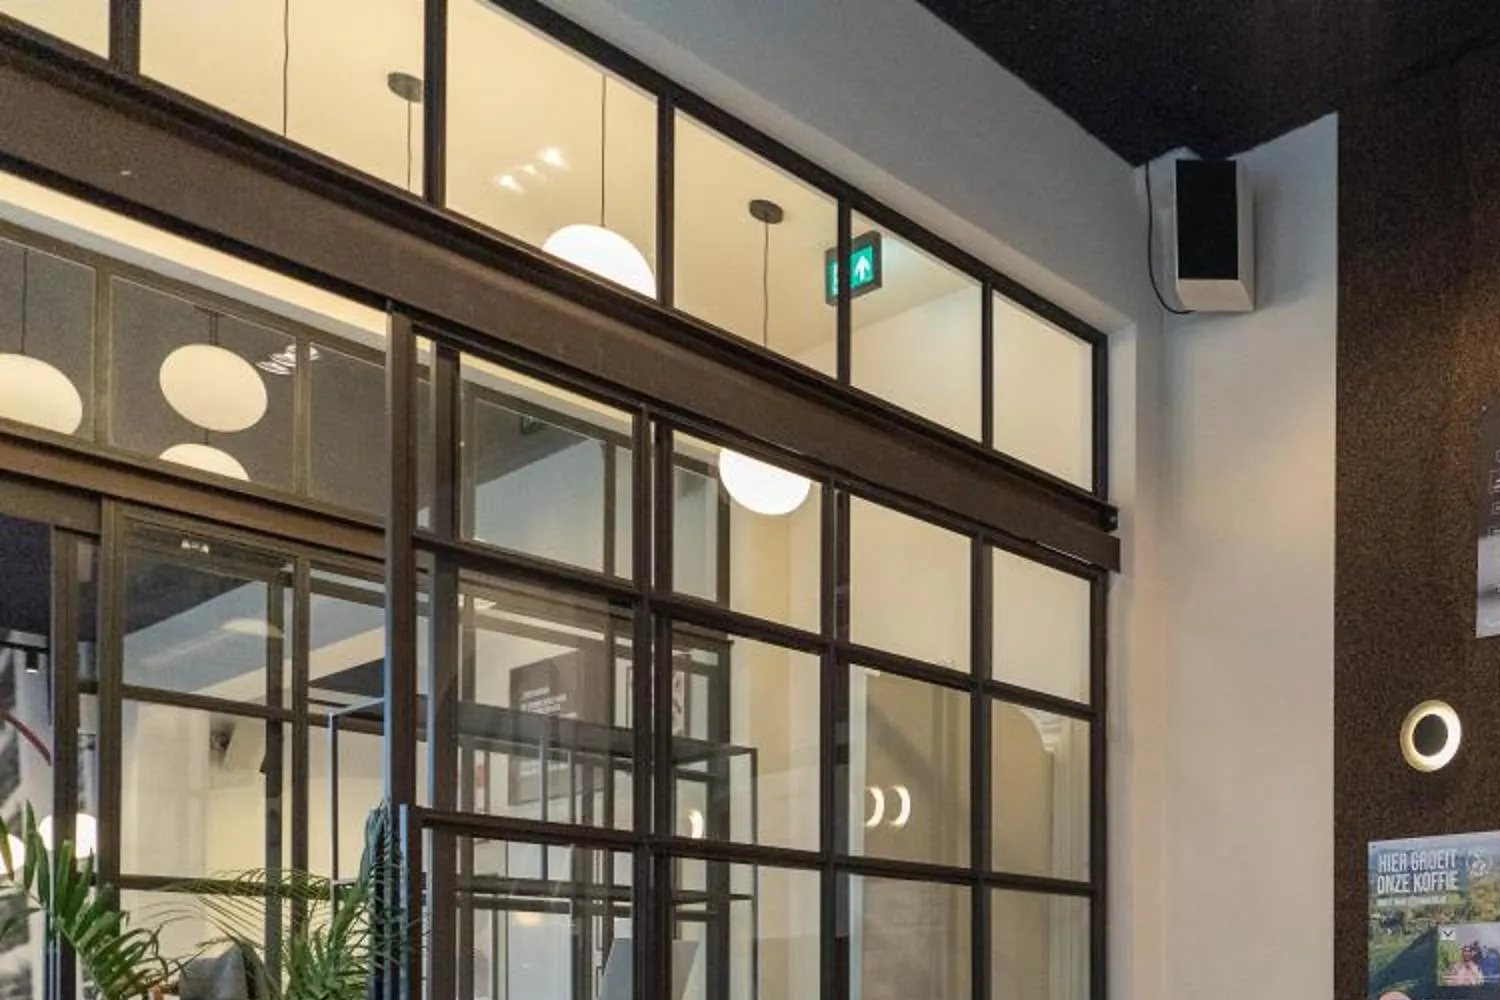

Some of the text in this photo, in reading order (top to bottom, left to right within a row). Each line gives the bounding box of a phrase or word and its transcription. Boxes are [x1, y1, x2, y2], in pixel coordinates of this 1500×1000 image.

[1378, 852, 1408, 874] HIER
[1377, 870, 1459, 894] ONZE KOFFIE
